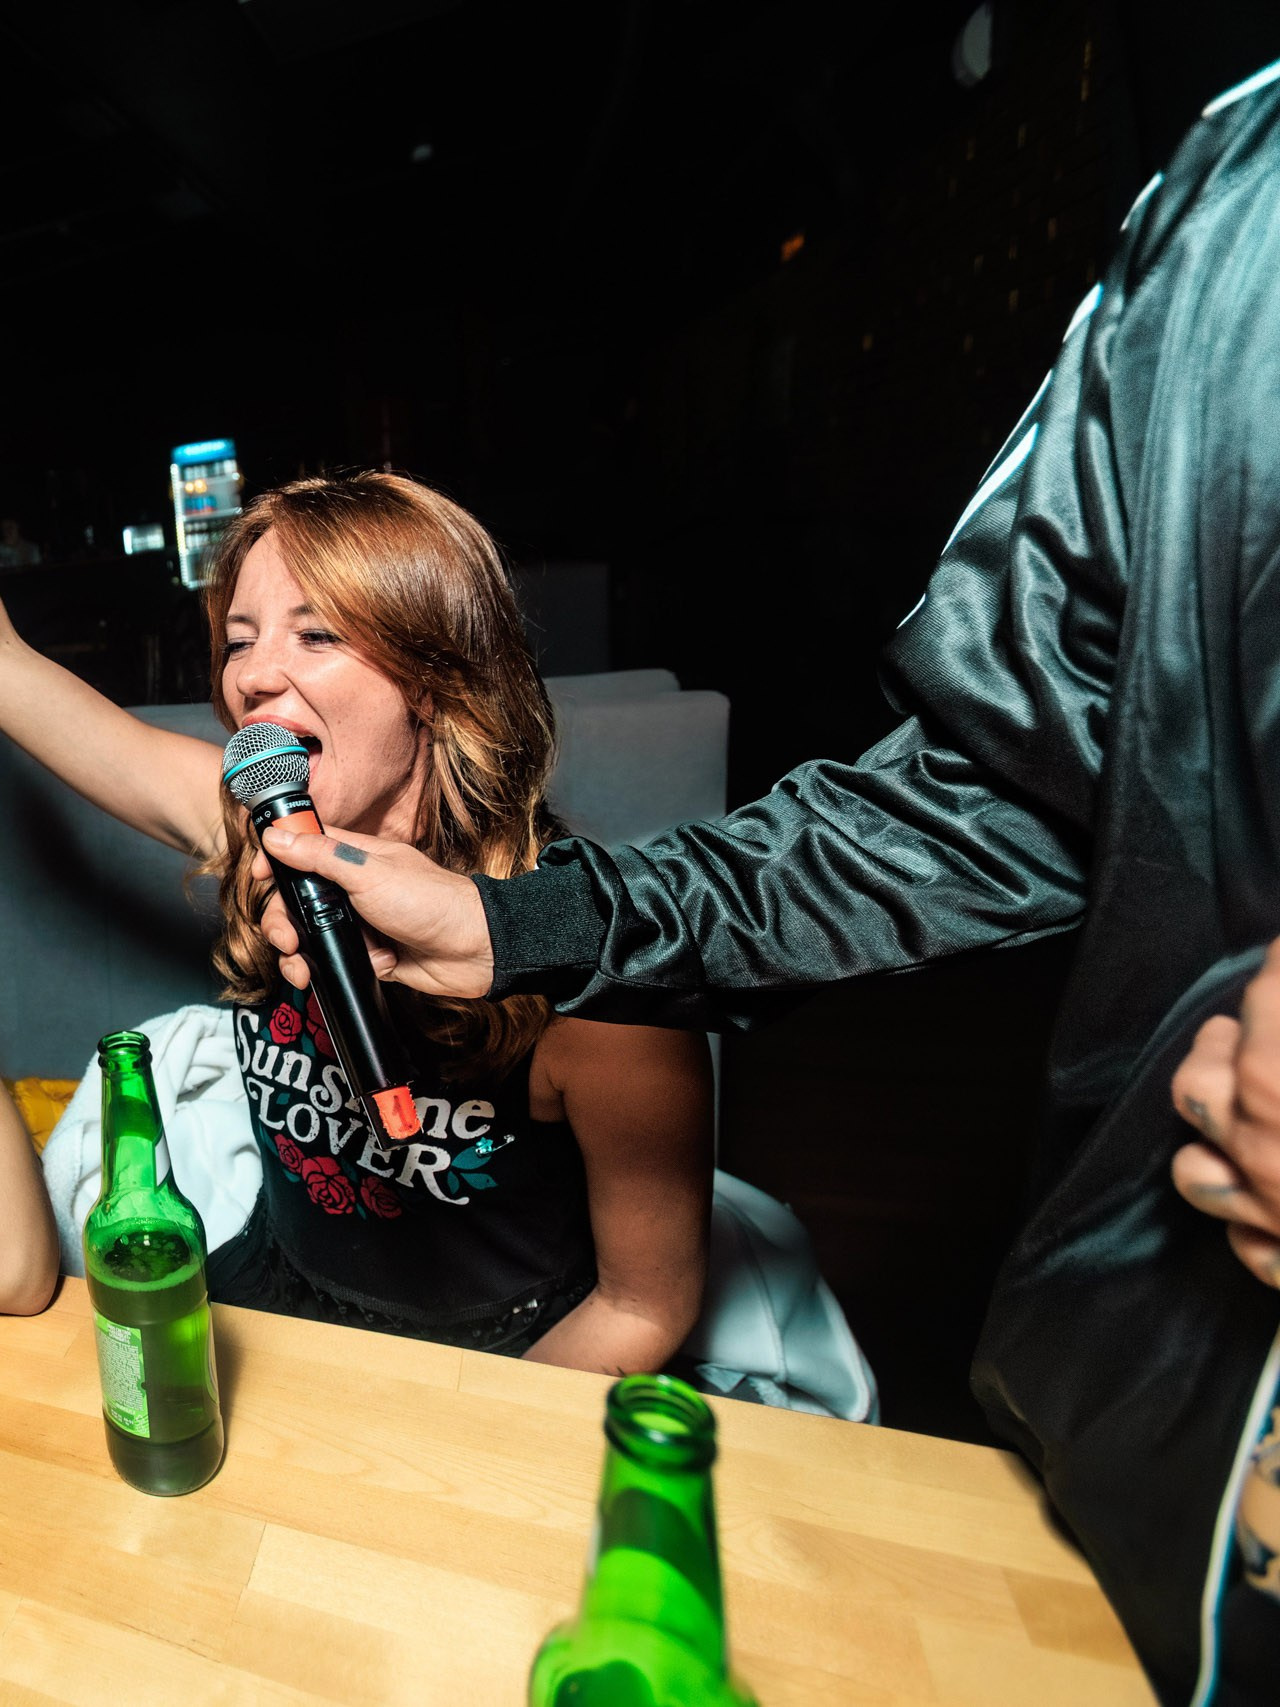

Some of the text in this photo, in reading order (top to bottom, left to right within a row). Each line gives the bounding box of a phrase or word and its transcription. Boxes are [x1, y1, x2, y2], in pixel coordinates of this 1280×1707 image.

[284, 799, 312, 809] SHURE
[236, 1008, 496, 1140] Sunsne
[392, 1094, 413, 1133] 1
